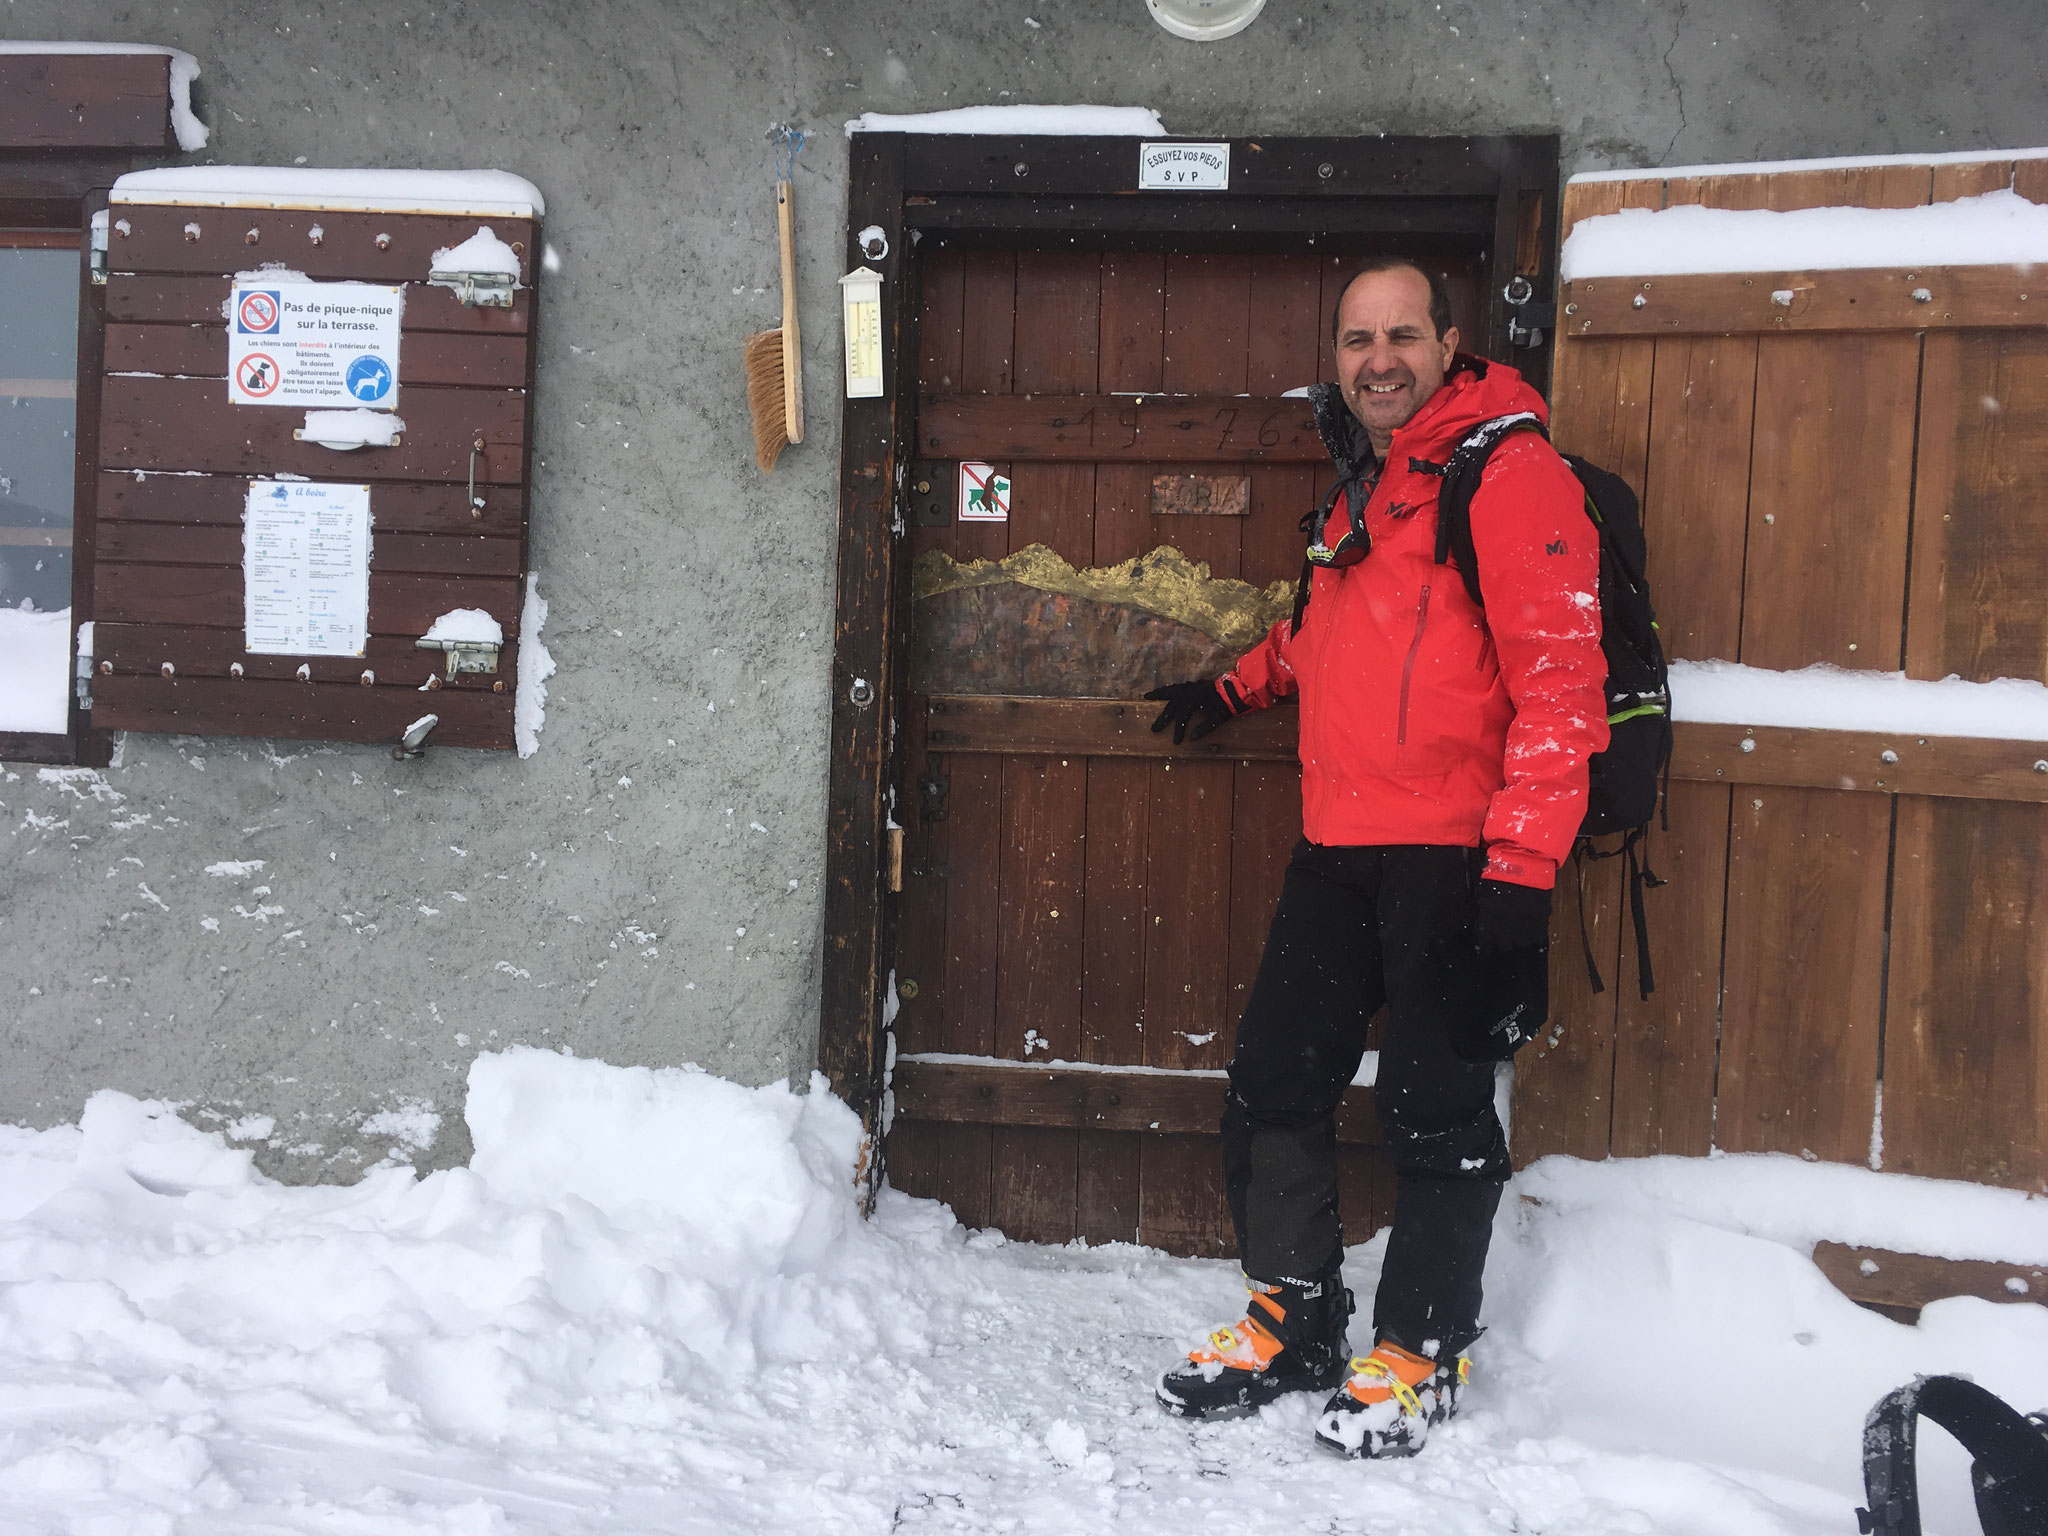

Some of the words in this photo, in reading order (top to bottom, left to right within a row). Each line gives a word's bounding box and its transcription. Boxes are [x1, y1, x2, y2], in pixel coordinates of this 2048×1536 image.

[1147, 150, 1182, 168] ESSUYEZ
[1183, 151, 1199, 162] VOS
[1199, 151, 1223, 170] PIEDS
[284, 302, 303, 313] Pas
[306, 302, 321, 314] de
[324, 303, 393, 317] pique-nique
[297, 320, 316, 329] sur
[318, 319, 328, 330] la
[331, 320, 378, 331] terrasse.
[299, 341, 327, 349] interdits
[329, 341, 333, 349] à
[334, 341, 367, 350] l'intérieur
[368, 342, 380, 350] des
[296, 350, 331, 358] bâtiments.
[308, 360, 334, 368] doivent
[286, 369, 340, 378] obligatoirement
[282, 377, 296, 385] être
[314, 387, 343, 396] l'alpage.
[305, 487, 327, 497] boire
